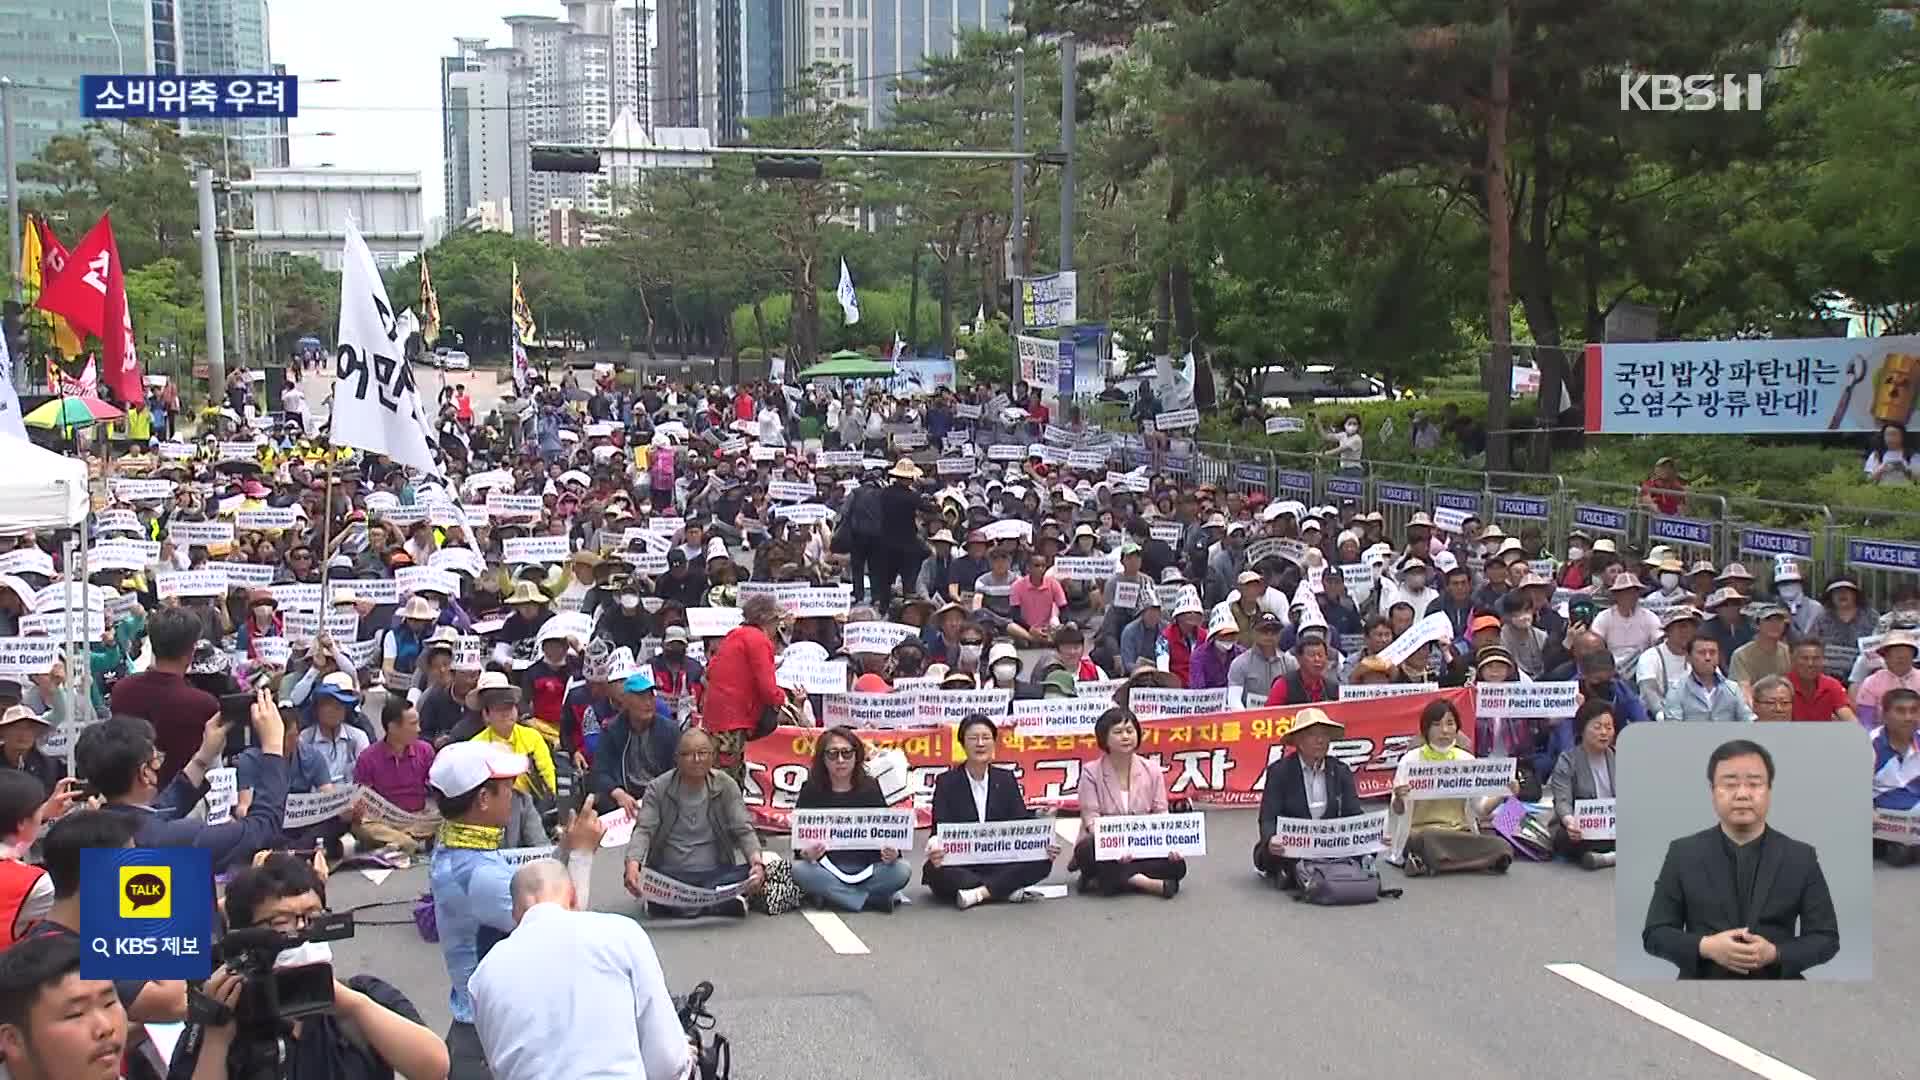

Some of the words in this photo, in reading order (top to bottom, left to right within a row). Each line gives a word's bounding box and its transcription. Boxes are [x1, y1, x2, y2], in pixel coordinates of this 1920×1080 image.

[1615, 361, 1665, 389] 국민
[1671, 359, 1724, 388] 밥상
[1728, 357, 1840, 388] 파탄내는
[1614, 389, 1693, 418] 오염수
[1696, 389, 1750, 418] 방류
[1755, 388, 1817, 418] 반대!
[1662, 522, 1685, 537] POLICE
[1685, 526, 1700, 540] LINE
[1754, 533, 1782, 549] POLICE
[1782, 538, 1798, 552] LINE
[1864, 546, 1896, 562] POLICE
[1160, 705, 1192, 715] Pacific
[1194, 703, 1223, 715] Ocean!
[1481, 698, 1506, 709] SOS!!
[1508, 698, 1541, 709] Pacific
[1543, 698, 1576, 709] Ocean!
[851, 708, 882, 719] Pacific
[884, 706, 916, 719] Ocean!
[1046, 715, 1078, 726] Pacific
[1169, 723, 1242, 744] 저지를
[1408, 778, 1434, 790] SOS!!
[1437, 777, 1472, 789] Pacific
[1474, 775, 1510, 787] Ocean!
[1579, 816, 1606, 829] SOS!!
[798, 827, 826, 839] SOS!!
[829, 827, 867, 839] Pacific
[870, 827, 908, 839] Ocean!
[1099, 836, 1125, 849] SOS!!
[1128, 835, 1163, 847] Pacific
[1165, 833, 1200, 846] Ocean!
[1281, 835, 1311, 849] SOS!!
[1314, 836, 1351, 848] Pacific
[1352, 829, 1384, 846] Ocean!
[943, 842, 971, 854] SOS!!
[974, 841, 1012, 853] Pacific
[1014, 837, 1050, 851] Ocean!
